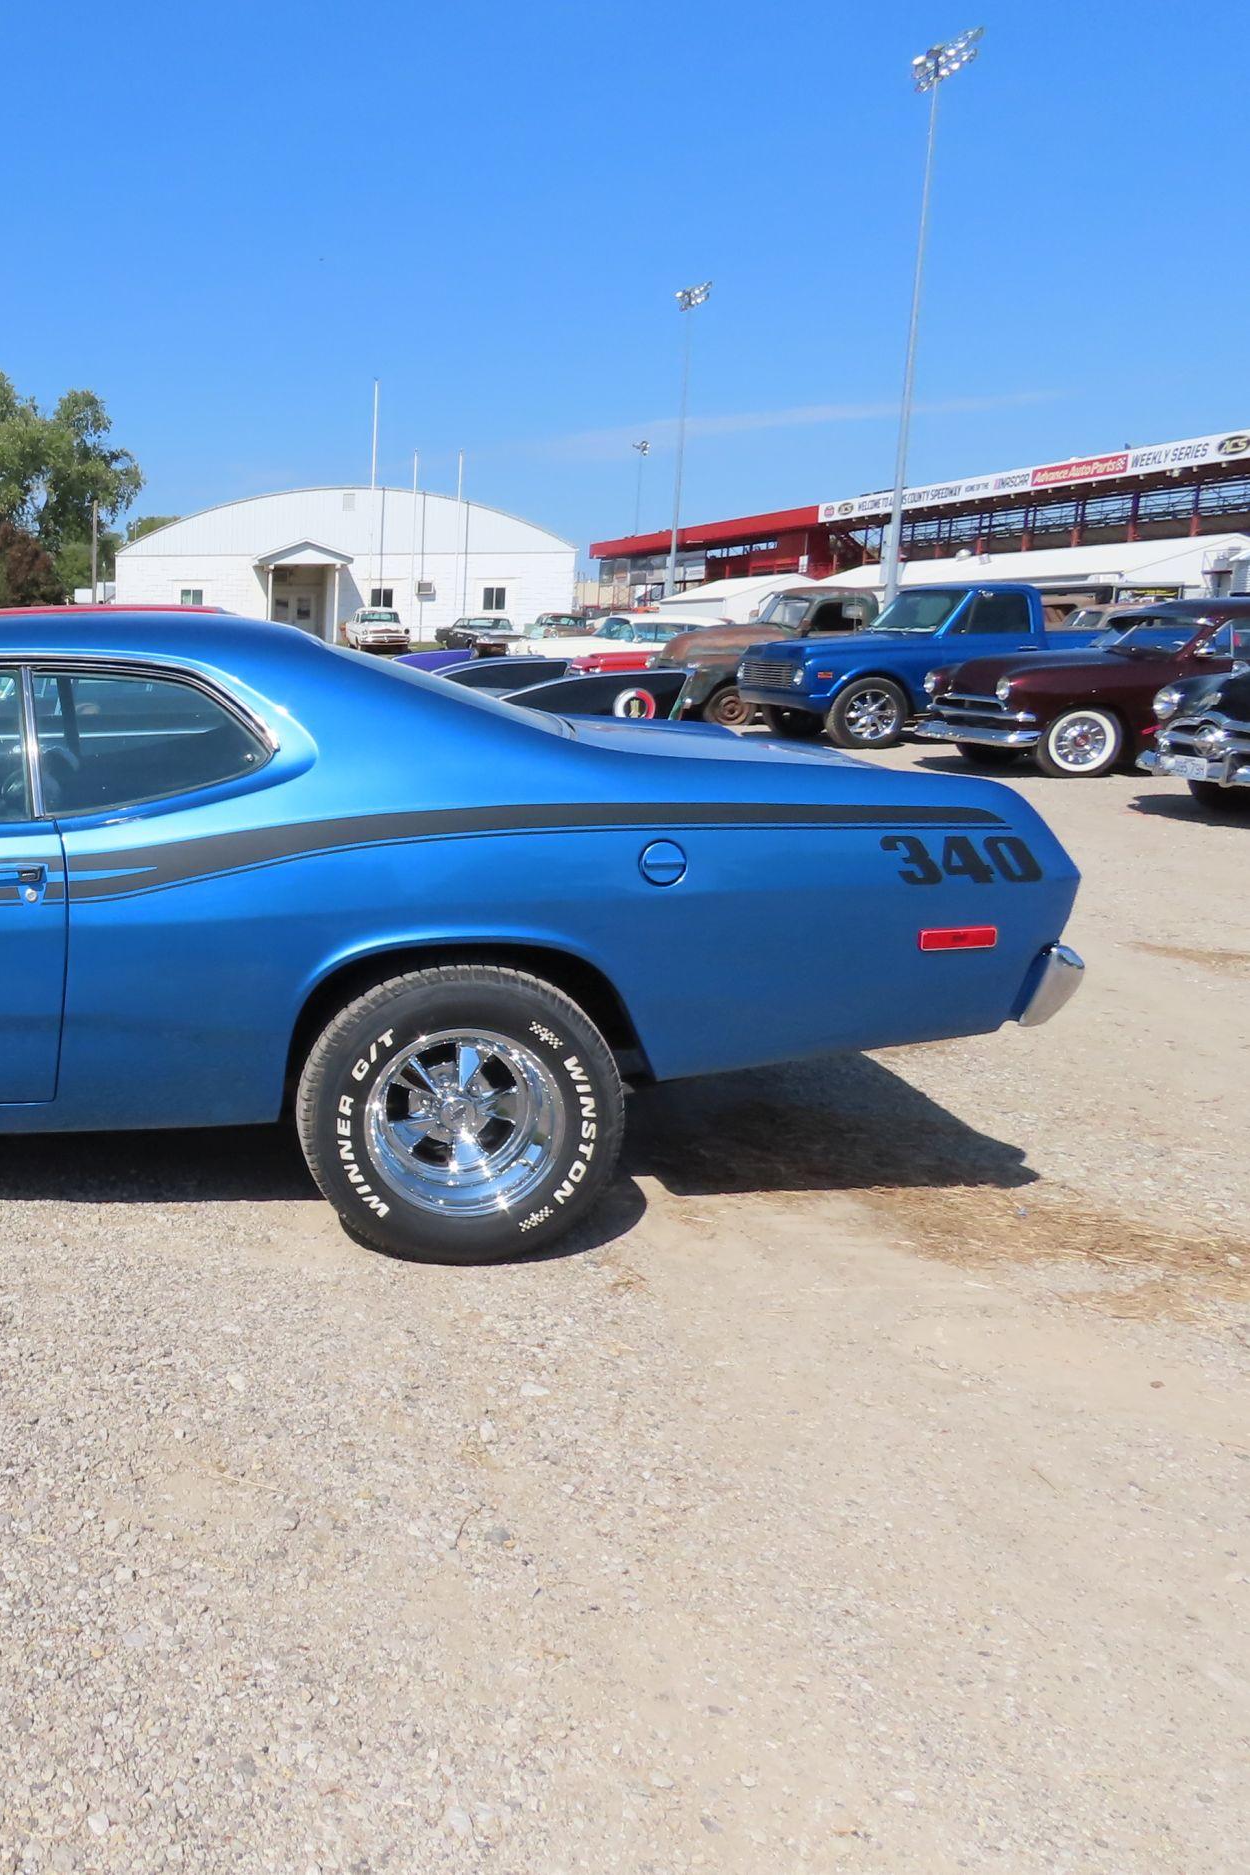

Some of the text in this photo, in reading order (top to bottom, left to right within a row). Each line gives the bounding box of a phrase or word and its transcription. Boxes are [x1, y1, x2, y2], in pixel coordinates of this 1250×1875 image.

[1131, 443, 1210, 468] WEEKLY SERIES
[998, 473, 1030, 489] NASCAR
[1034, 460, 1115, 484] Advance Auto Parts
[858, 498, 881, 512] WELCOME
[907, 490, 929, 504] COUNTY
[930, 485, 962, 500] SPEEDWAY
[880, 836, 1043, 885] 340
[336, 1028, 394, 1218] WINNER G/T
[553, 1055, 597, 1205] WINSTON
